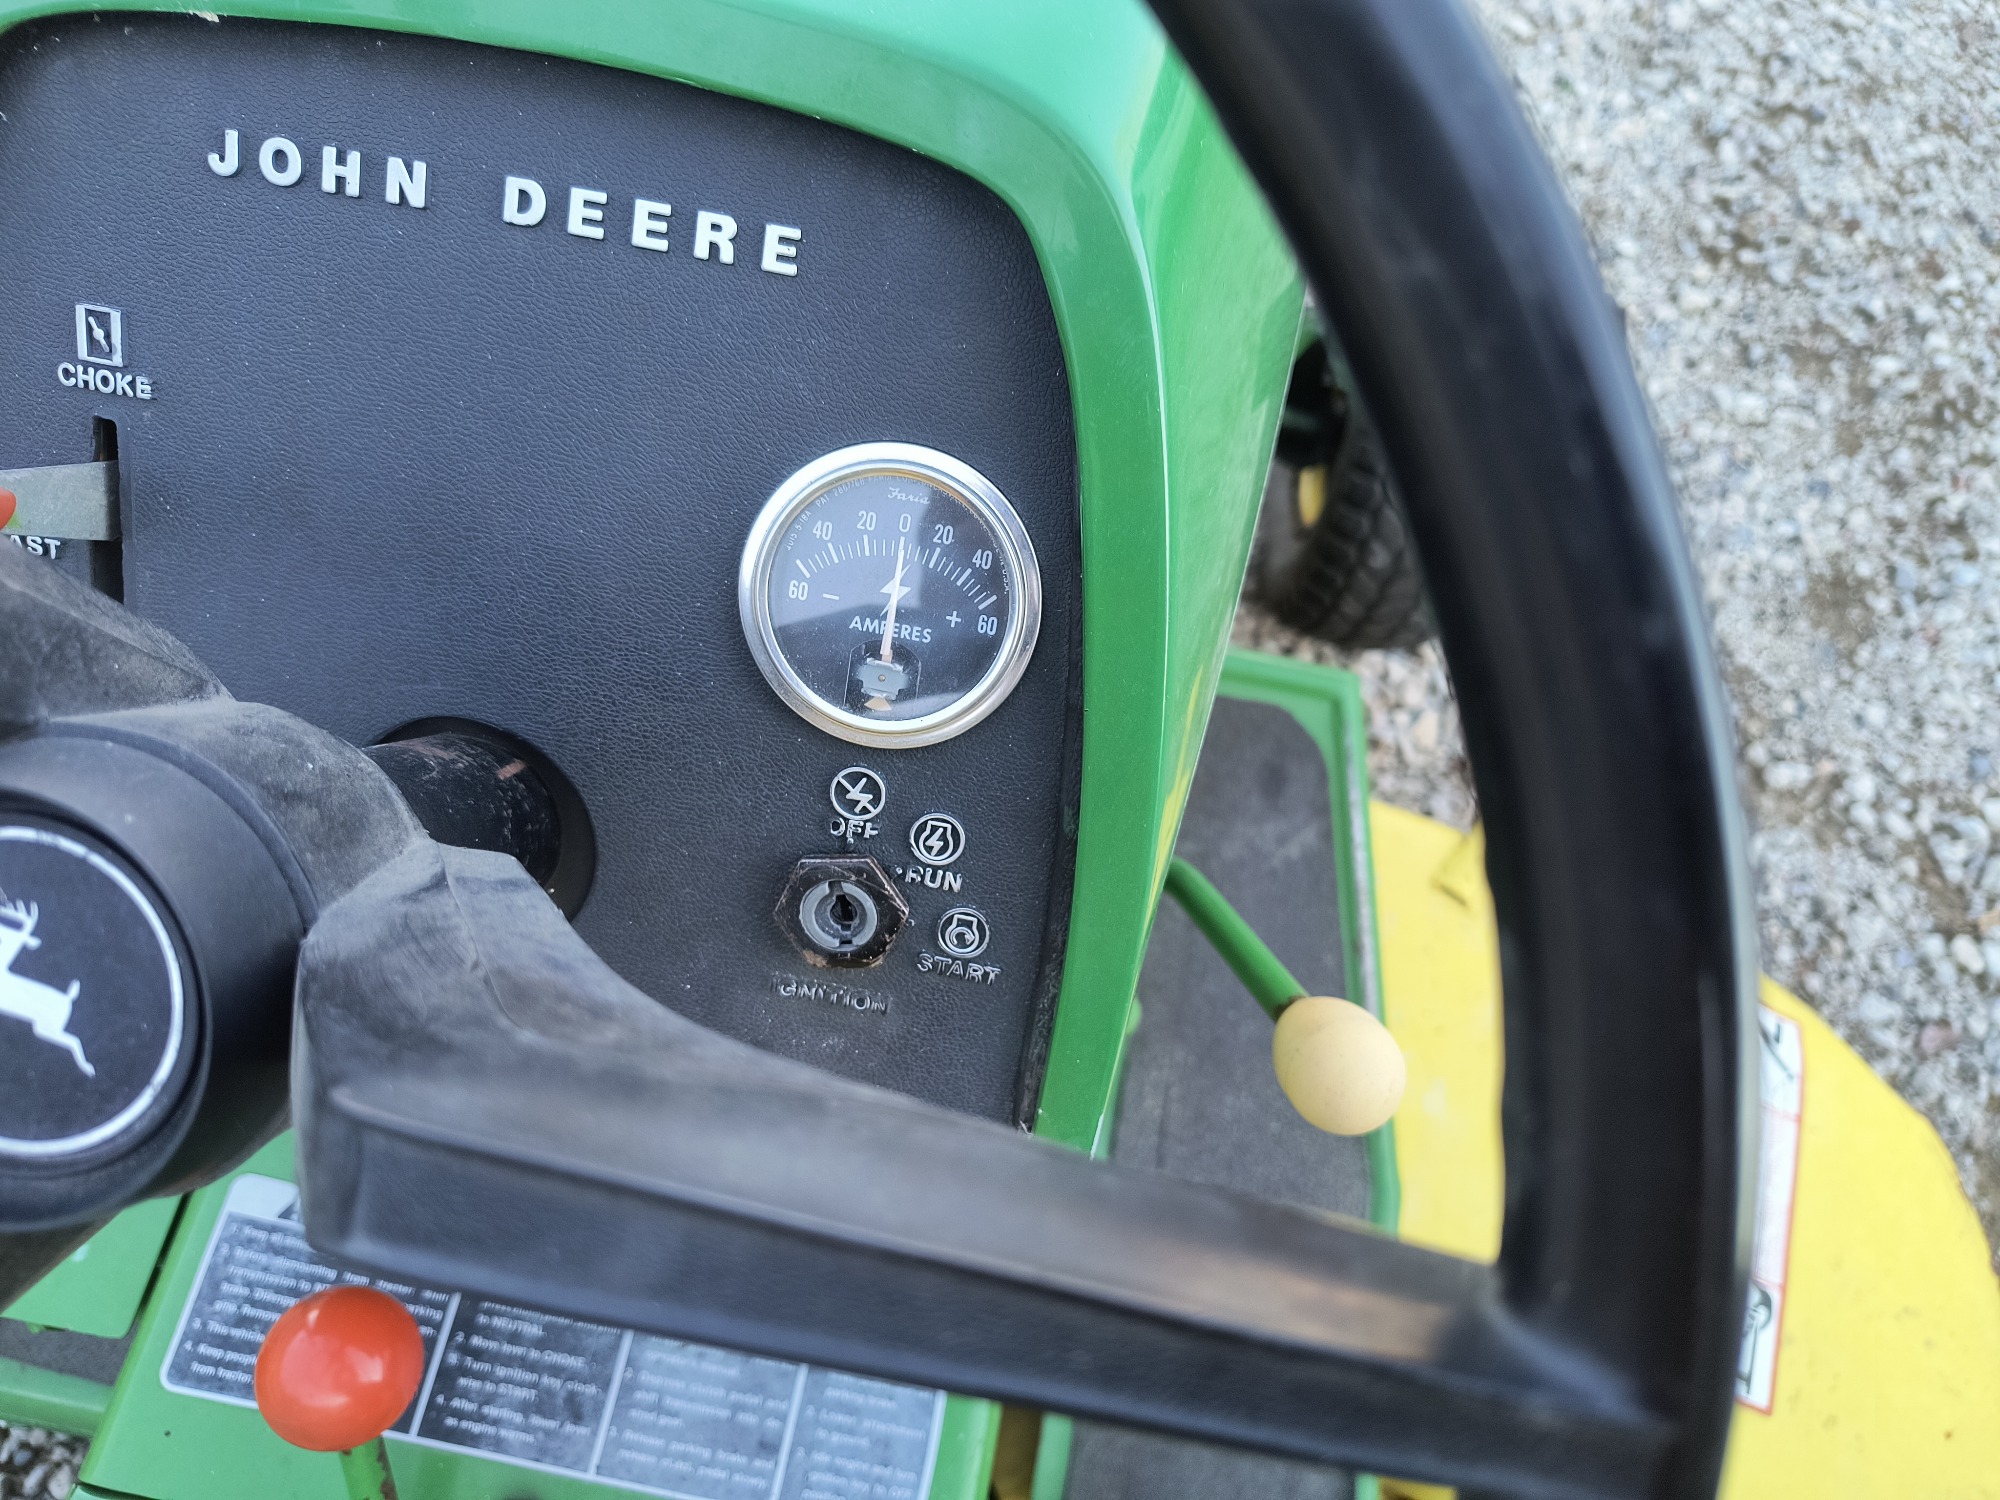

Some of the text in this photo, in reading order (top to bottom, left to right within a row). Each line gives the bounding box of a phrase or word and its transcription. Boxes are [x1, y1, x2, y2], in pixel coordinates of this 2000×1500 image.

[207, 128, 802, 276] JOHN DEERE
[57, 361, 153, 400] CHOKE
[887, 486, 930, 505] Faria
[9, 534, 61, 560] AST
[812, 519, 833, 541] 40
[856, 510, 877, 531] 20
[899, 513, 911, 532] 0
[932, 523, 954, 545] 20
[972, 548, 993, 570] 40
[788, 581, 808, 601] 60
[849, 615, 932, 643] AMPERES
[977, 615, 998, 635] 60
[830, 818, 879, 839] OFF
[905, 867, 963, 893] RUN
[917, 953, 1001, 985] START
